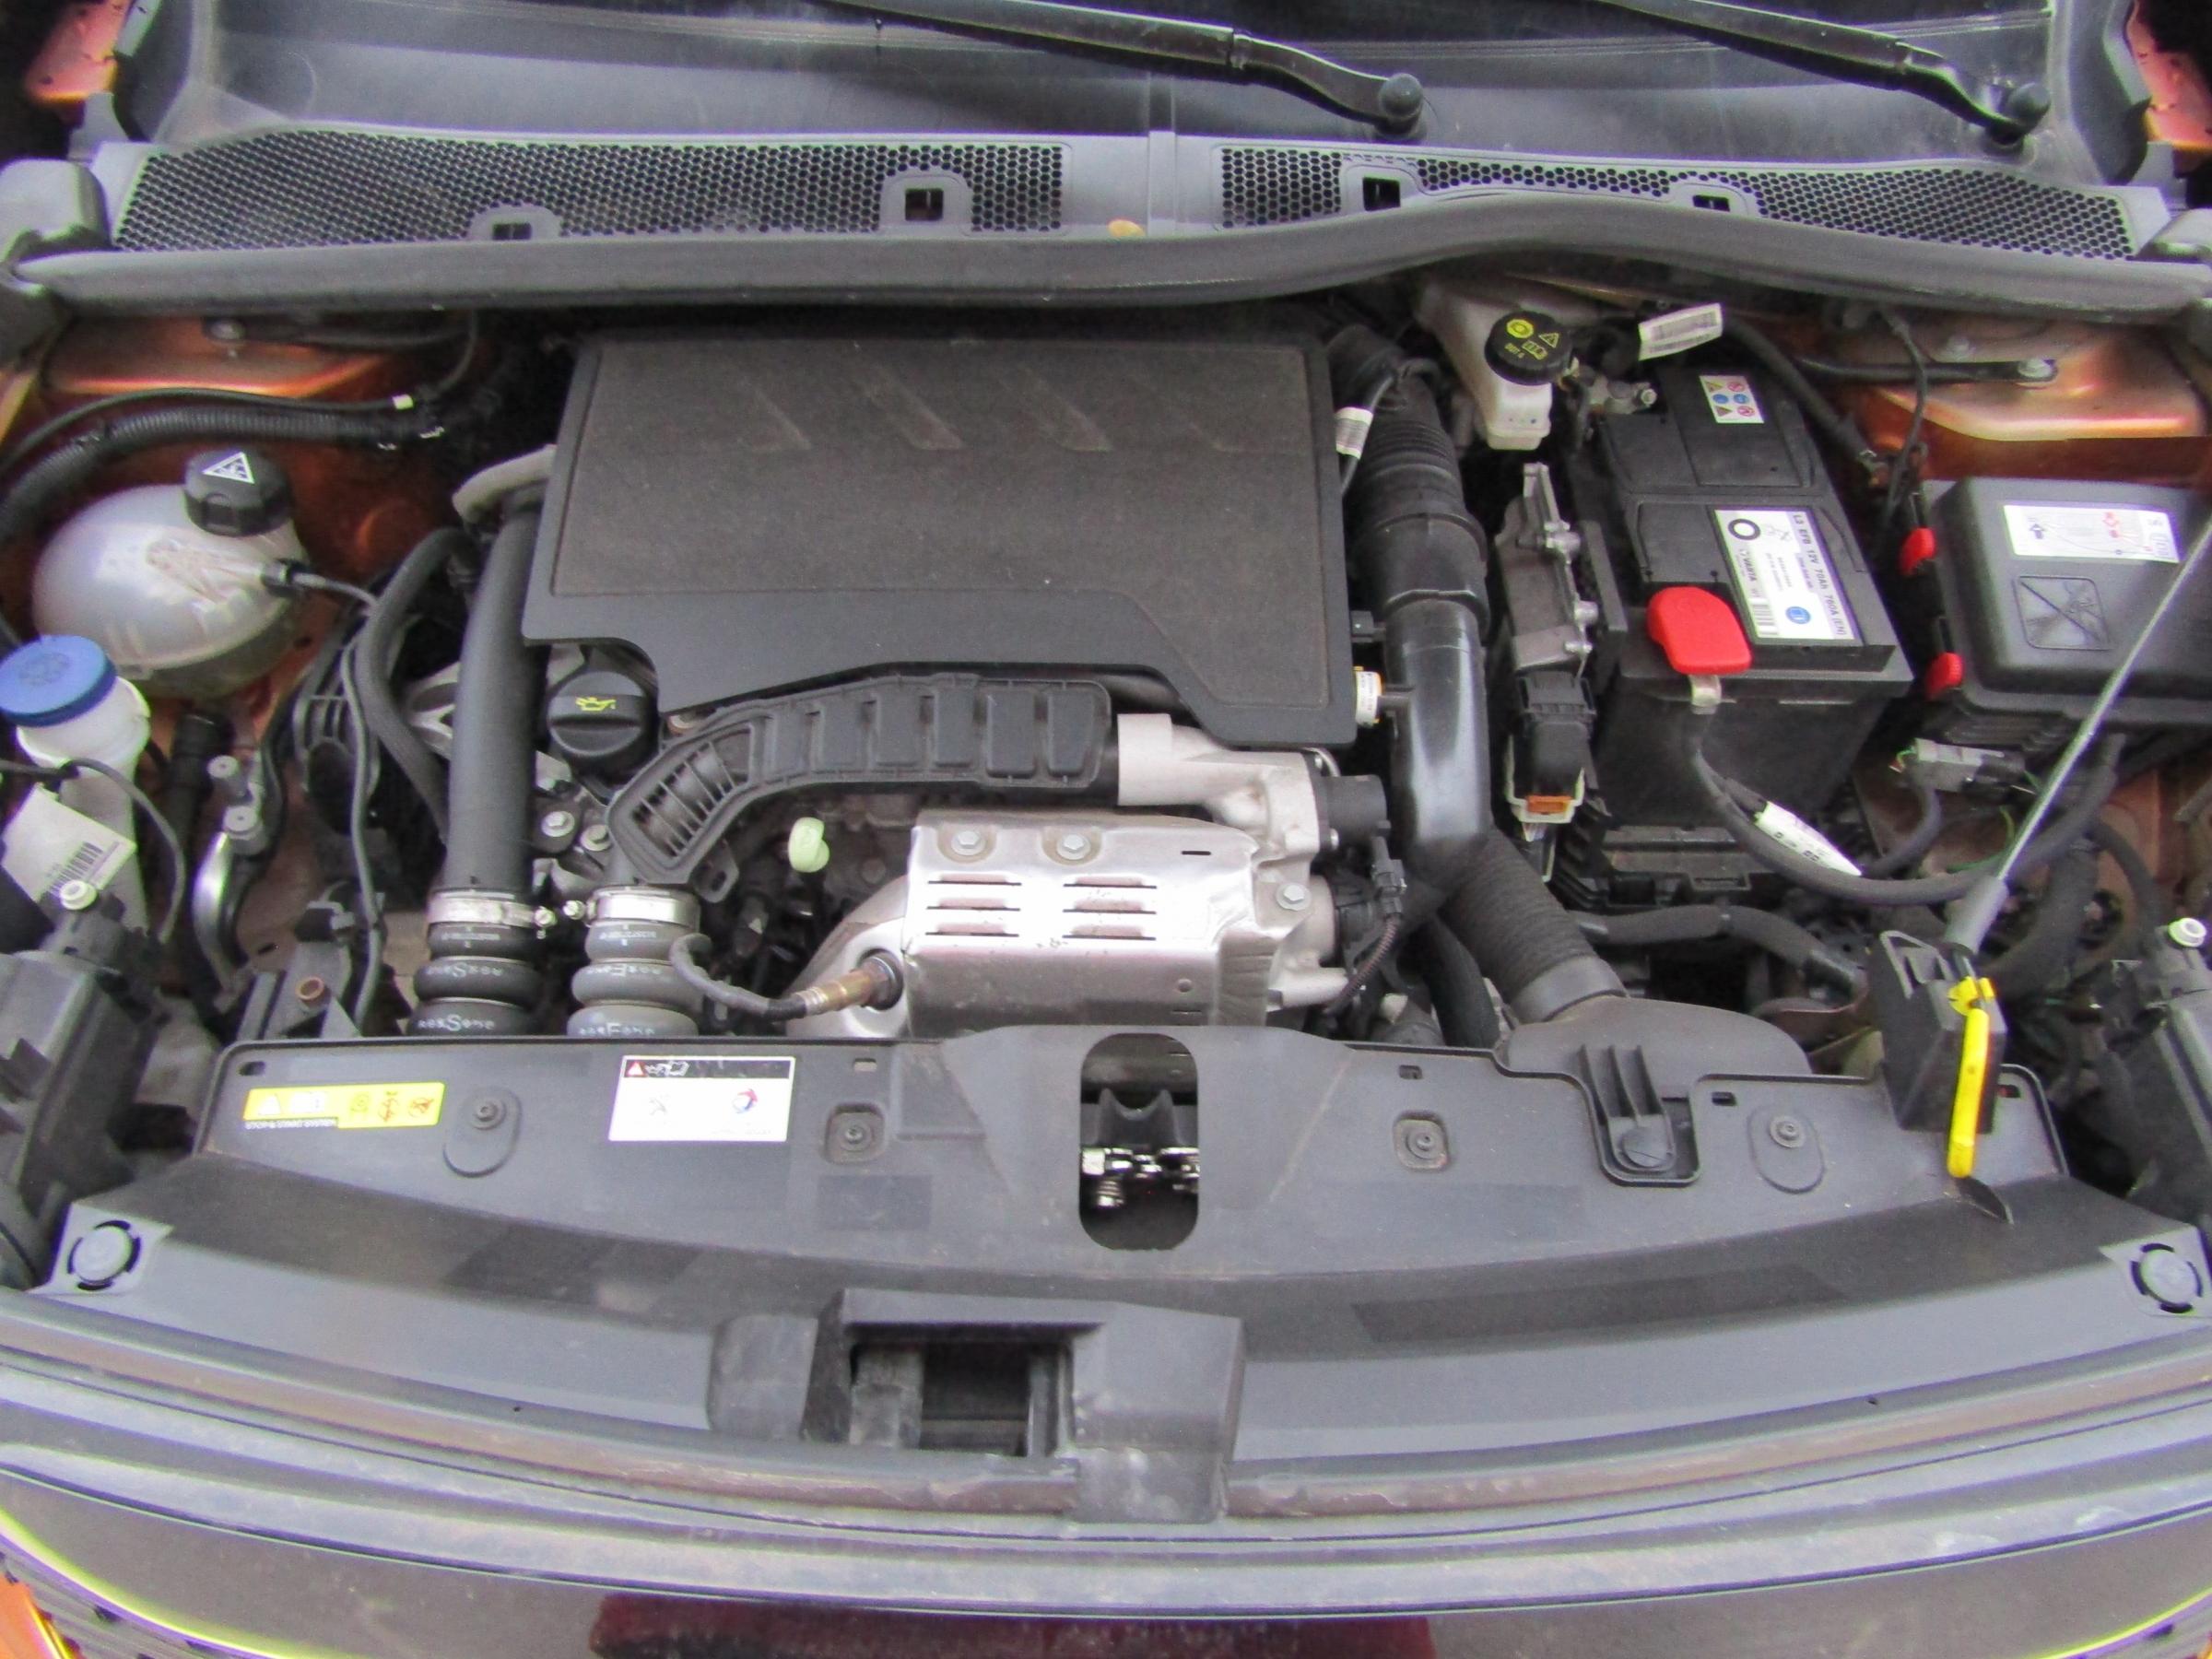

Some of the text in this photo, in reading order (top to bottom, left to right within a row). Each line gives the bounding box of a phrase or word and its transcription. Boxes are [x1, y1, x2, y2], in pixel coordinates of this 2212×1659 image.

[1743, 558, 1758, 582] VARTA
[1806, 550, 1819, 564] 12V
[1814, 569, 1830, 589] 70Ah
[1824, 594, 1840, 615] 760A
